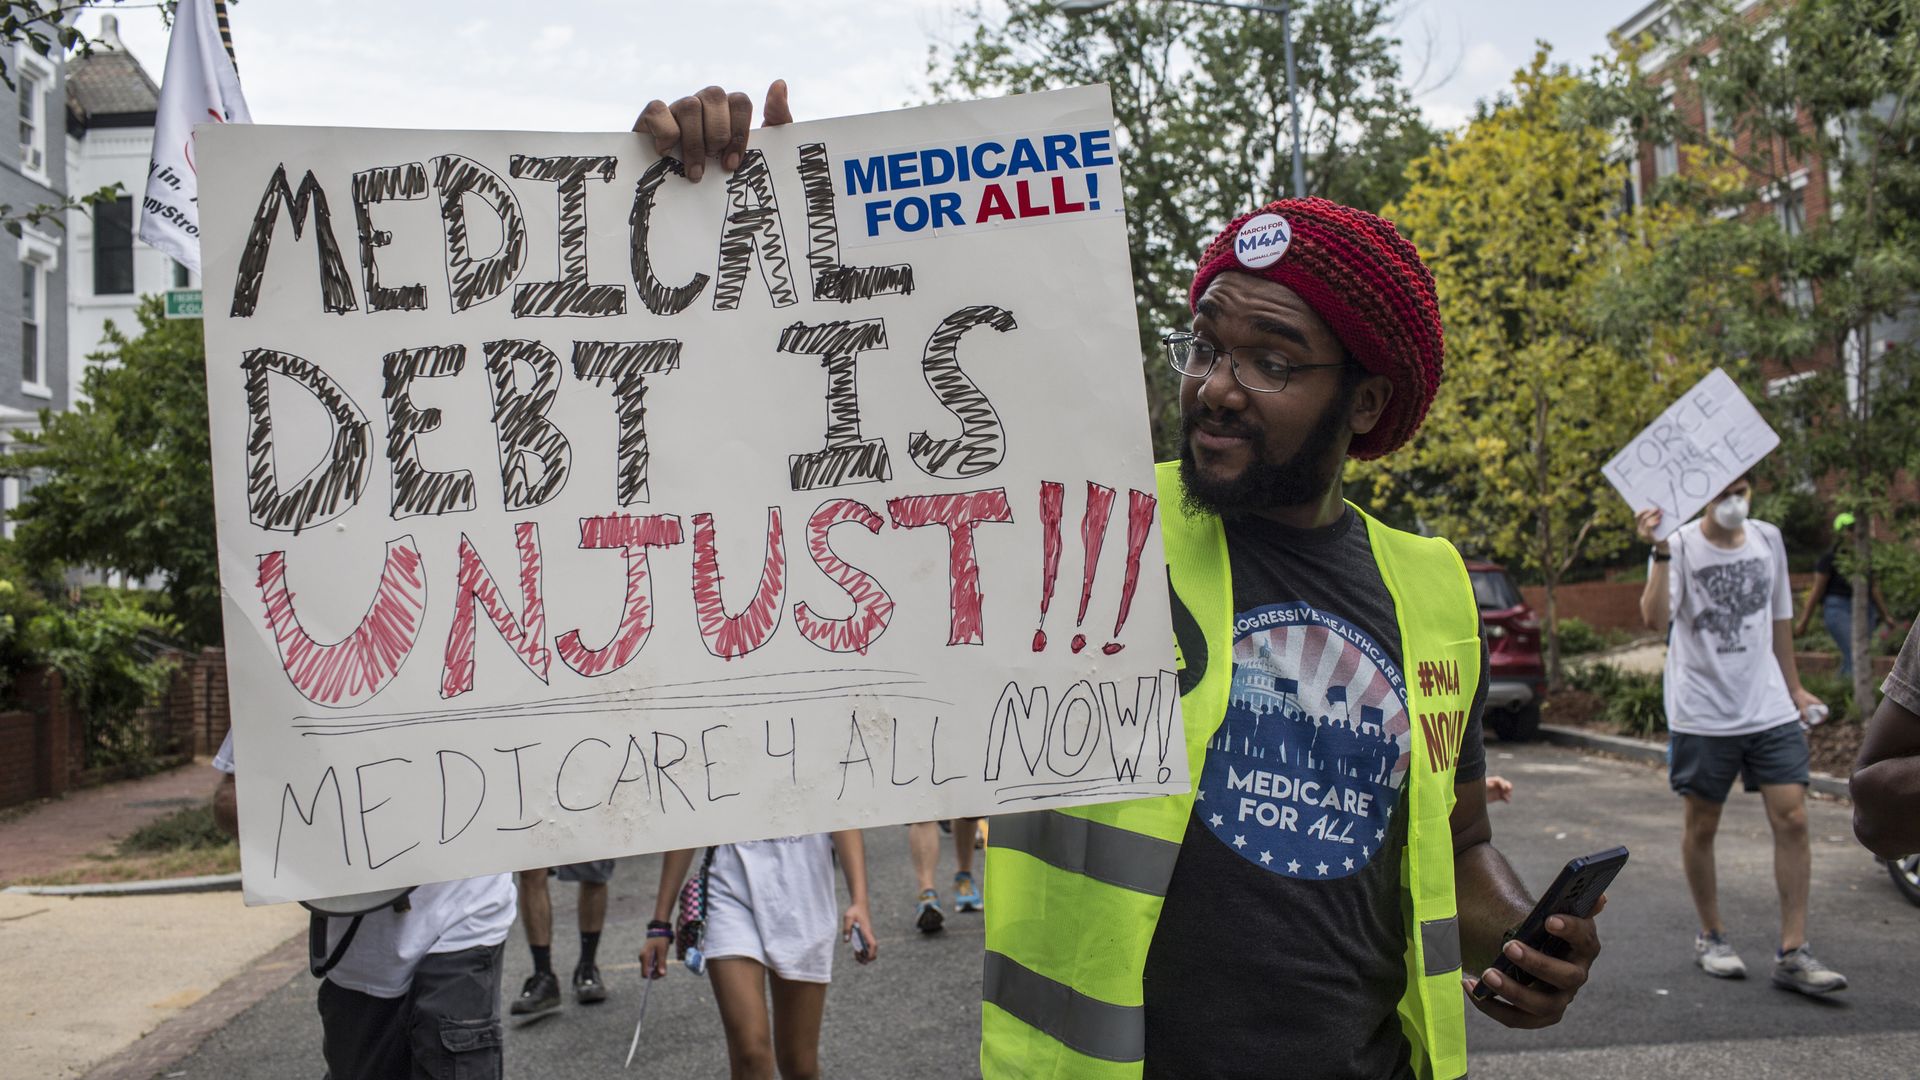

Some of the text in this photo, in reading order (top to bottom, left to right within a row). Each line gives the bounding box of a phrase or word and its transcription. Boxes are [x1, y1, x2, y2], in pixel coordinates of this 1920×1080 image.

[844, 129, 1114, 196] MEDICARE
[230, 143, 914, 318] MEDICAL
[865, 173, 1101, 237] FOR ALL!
[1240, 221, 1283, 237] MARCH FOR
[1238, 228, 1288, 254] M4A
[241, 305, 1018, 536] DEBT IS
[1613, 391, 1724, 490] FORCE
[1646, 426, 1755, 520] VOTE
[1660, 444, 1700, 478] THE
[1320, 615, 1402, 687] HEALTHCARE
[273, 669, 1178, 879] MEDICARE 4 ALL NOW!
[1226, 765, 1374, 818] MEDICARE
[1238, 797, 1355, 844] FOR ALL
